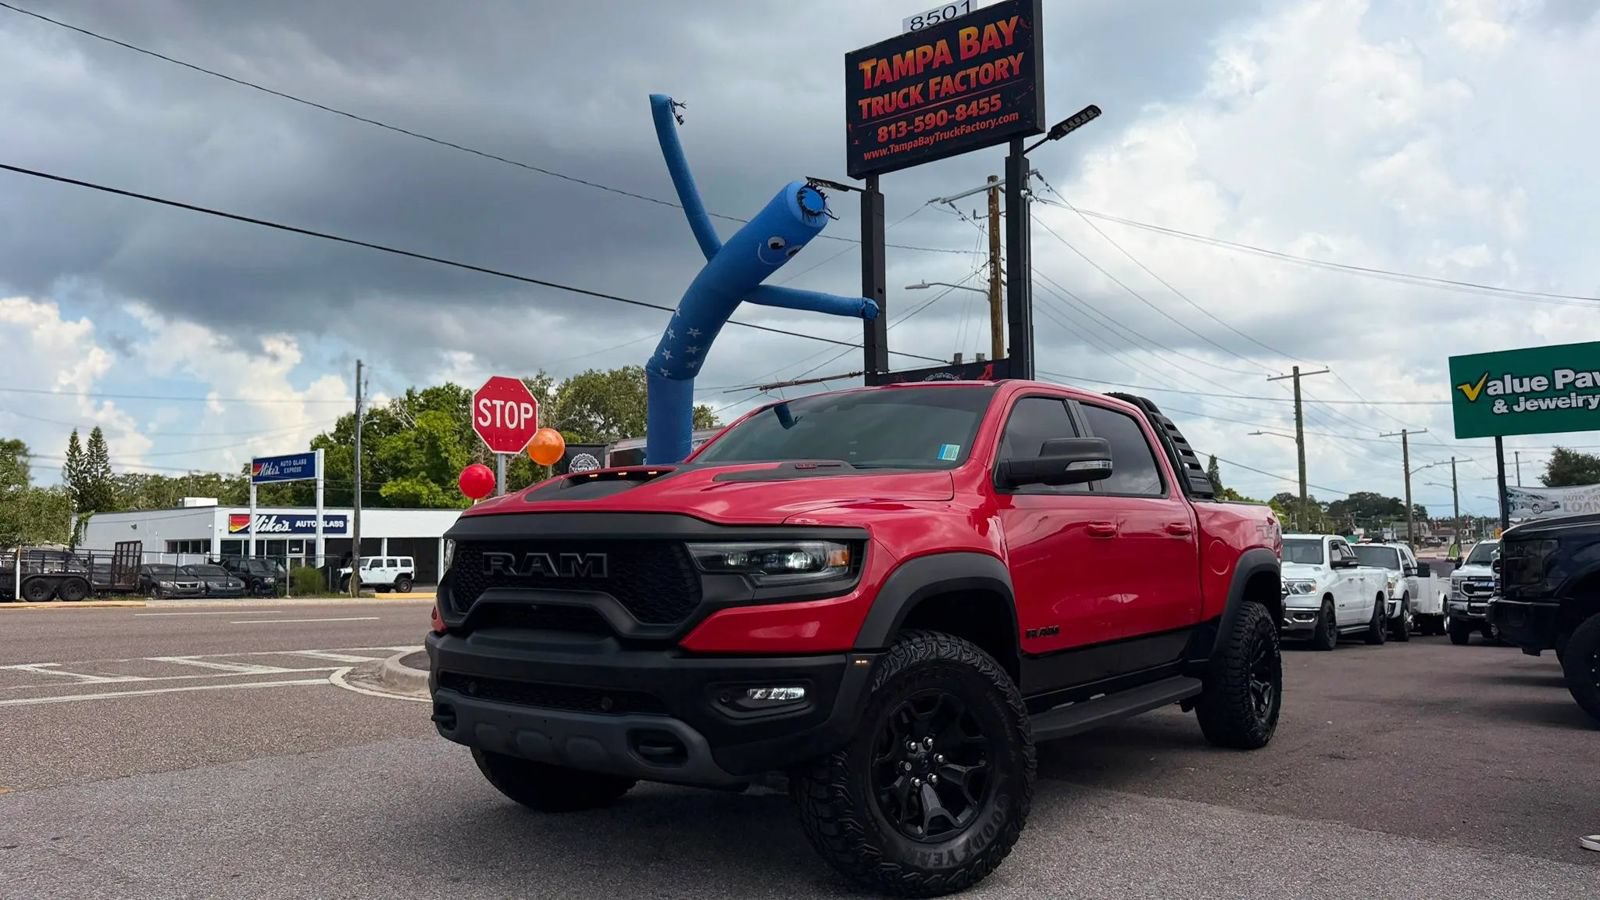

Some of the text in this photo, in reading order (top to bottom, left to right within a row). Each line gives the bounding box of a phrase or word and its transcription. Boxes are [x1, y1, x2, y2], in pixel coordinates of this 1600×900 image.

[910, 0, 971, 31] 8501
[858, 15, 1019, 90] TAMPA BAY
[858, 52, 1024, 119] TRUCK FACTORY
[877, 93, 1002, 143] 813-590-8455
[863, 111, 1019, 161] www.TampaBayTruckFactory.com
[478, 398, 533, 430] STOP
[1492, 392, 1600, 414] & Jewelry
[295, 520, 316, 528] AUTO
[482, 551, 608, 579] RAM
